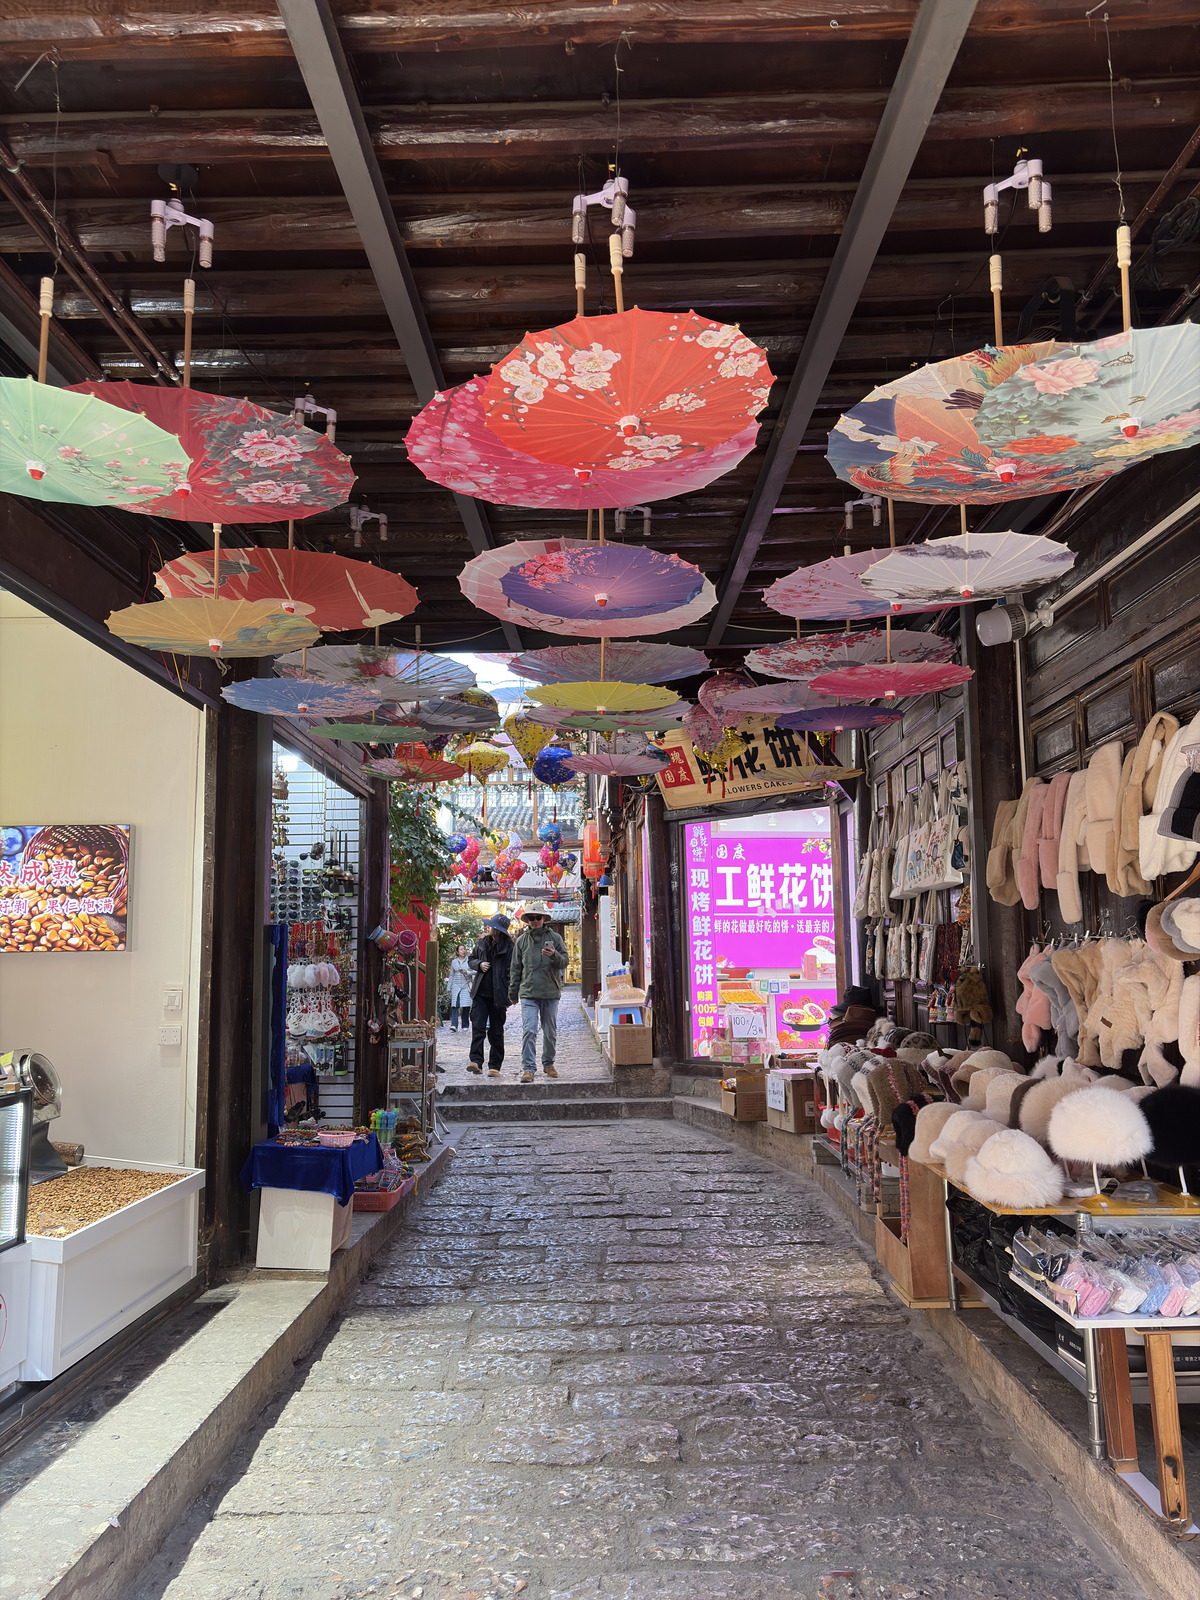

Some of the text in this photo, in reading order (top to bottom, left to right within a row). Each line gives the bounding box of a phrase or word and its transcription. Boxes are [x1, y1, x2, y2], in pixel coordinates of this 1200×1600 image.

[724, 783, 762, 795] LOWERS
[47, 898, 114, 913] 果仁饱满
[691, 868, 714, 985] 现烤鲜花饼
[697, 991, 713, 1001] 购满
[693, 1004, 717, 1014] 100元
[698, 1016, 714, 1027] 包邮
